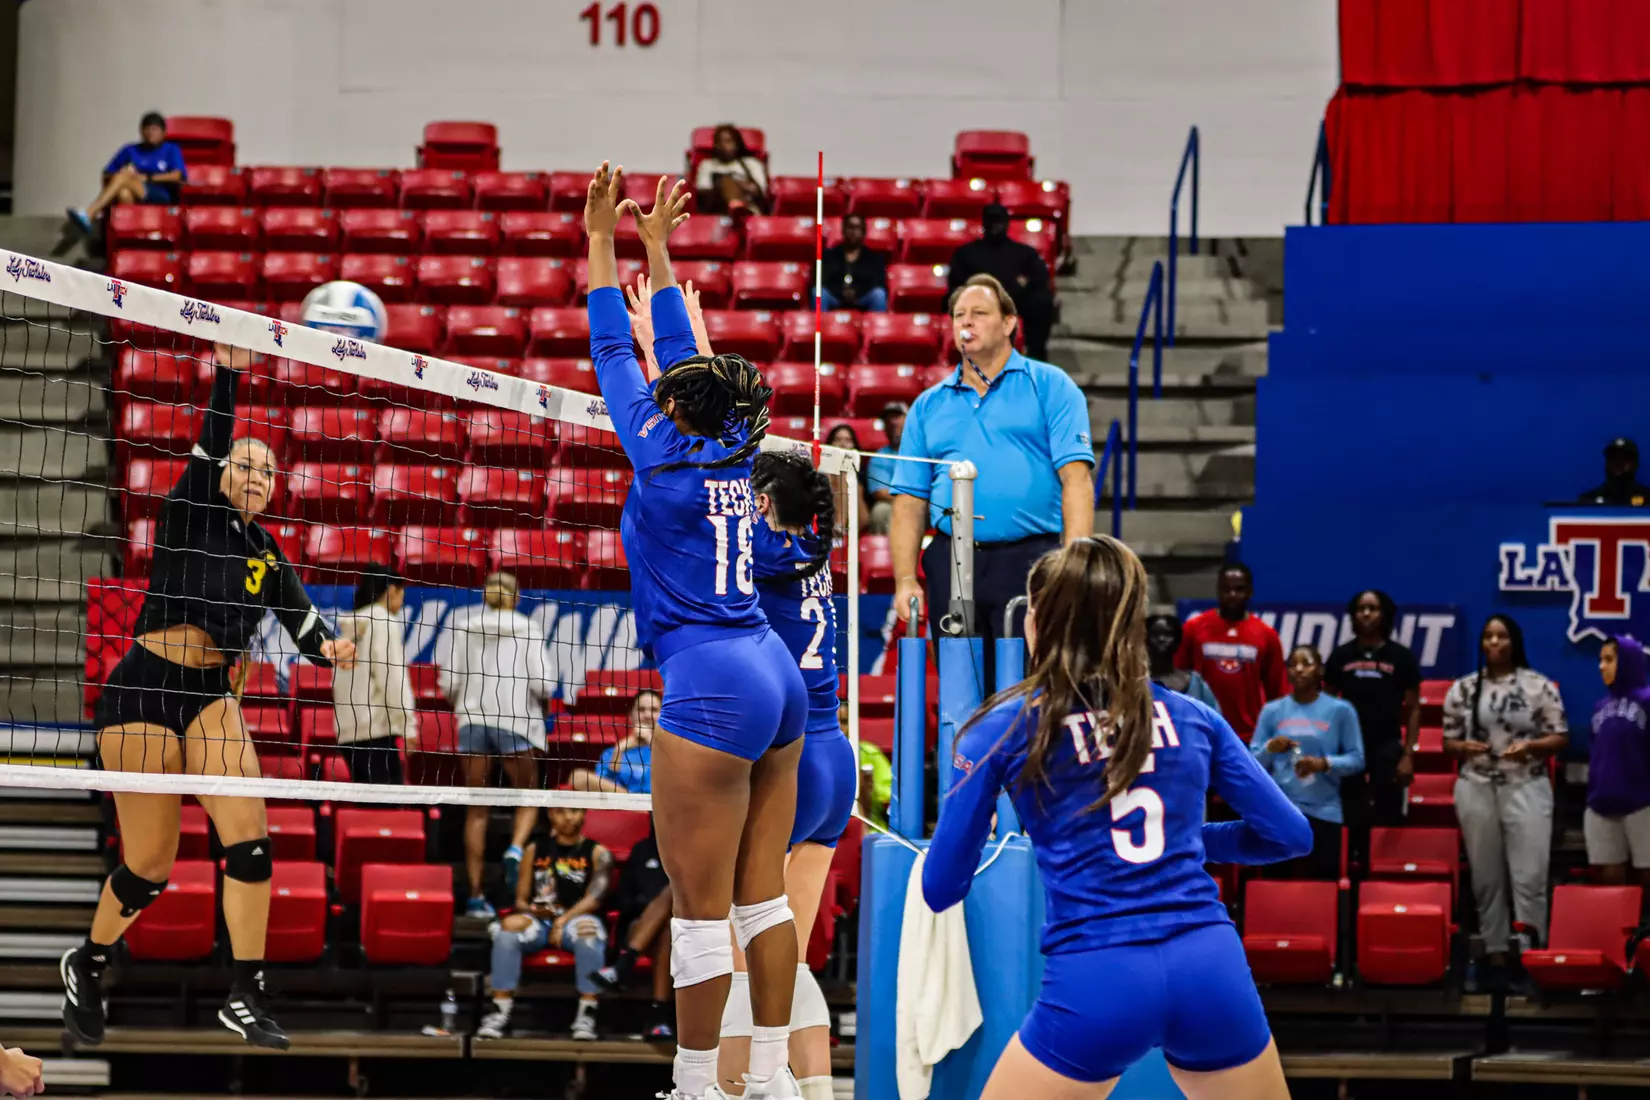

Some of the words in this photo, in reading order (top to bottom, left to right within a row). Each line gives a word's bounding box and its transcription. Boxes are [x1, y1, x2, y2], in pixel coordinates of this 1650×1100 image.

[578, 0, 662, 47] 110
[245, 559, 267, 595] 3
[1499, 544, 1573, 591] LA
[1550, 516, 1650, 619] T
[800, 596, 837, 671] 2
[952, 753, 974, 777] SA
[1062, 700, 1181, 766] TEH
[1108, 752, 1166, 865] 5
